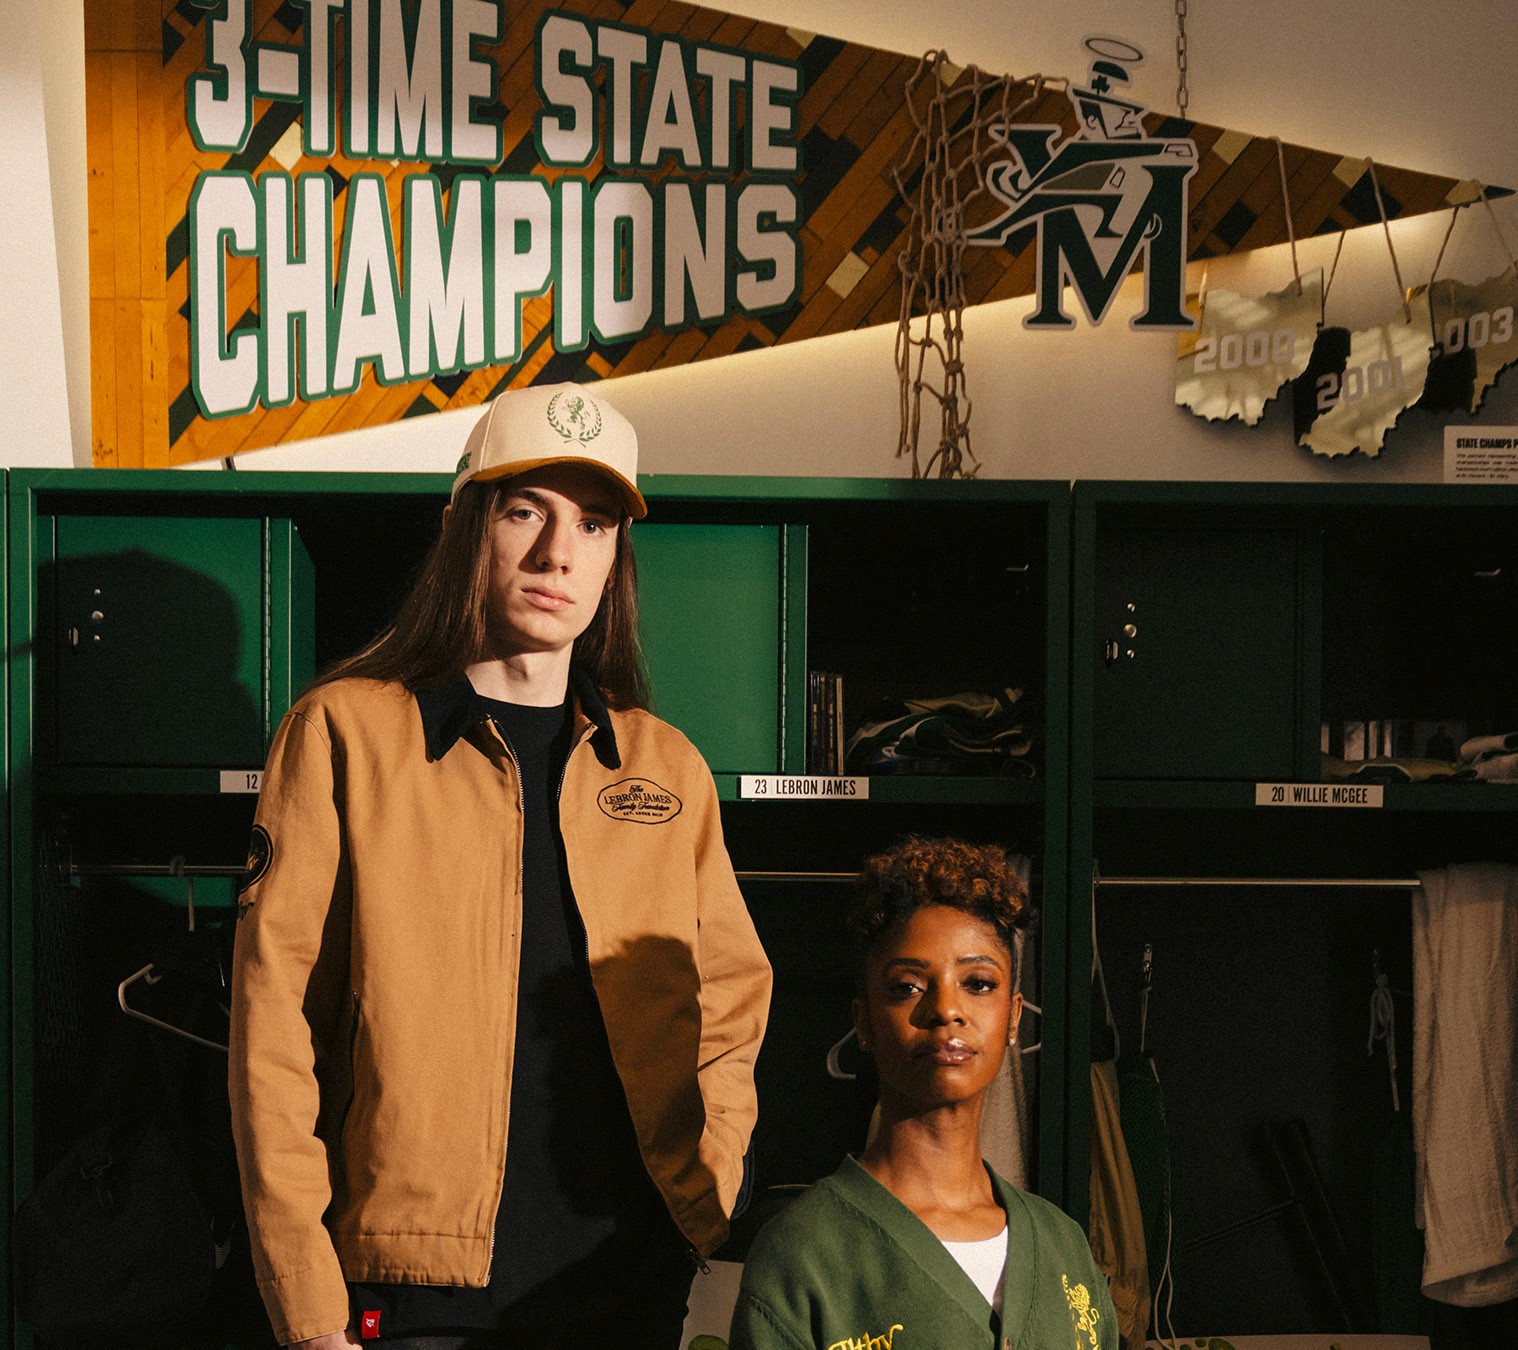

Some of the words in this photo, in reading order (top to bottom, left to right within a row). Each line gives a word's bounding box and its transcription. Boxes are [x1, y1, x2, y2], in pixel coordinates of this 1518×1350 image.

[190, 0, 502, 164] 3-TIME
[536, 11, 800, 174] STATE
[190, 173, 800, 417] CHAMPIONS
[1433, 306, 1516, 357] 003
[1193, 329, 1297, 373] 2000
[1456, 437, 1479, 449] STATE
[1480, 437, 1512, 449] CHAMPS
[246, 773, 258, 790] 12
[754, 778, 767, 795] 23
[776, 779, 818, 795] LEBRON
[821, 779, 857, 796] JAMES
[604, 792, 642, 805] LEBRON
[642, 792, 672, 804] JAMES
[1271, 785, 1285, 803] 20
[1293, 786, 1329, 803] WILLIE
[1332, 787, 1369, 804] MCGEE
